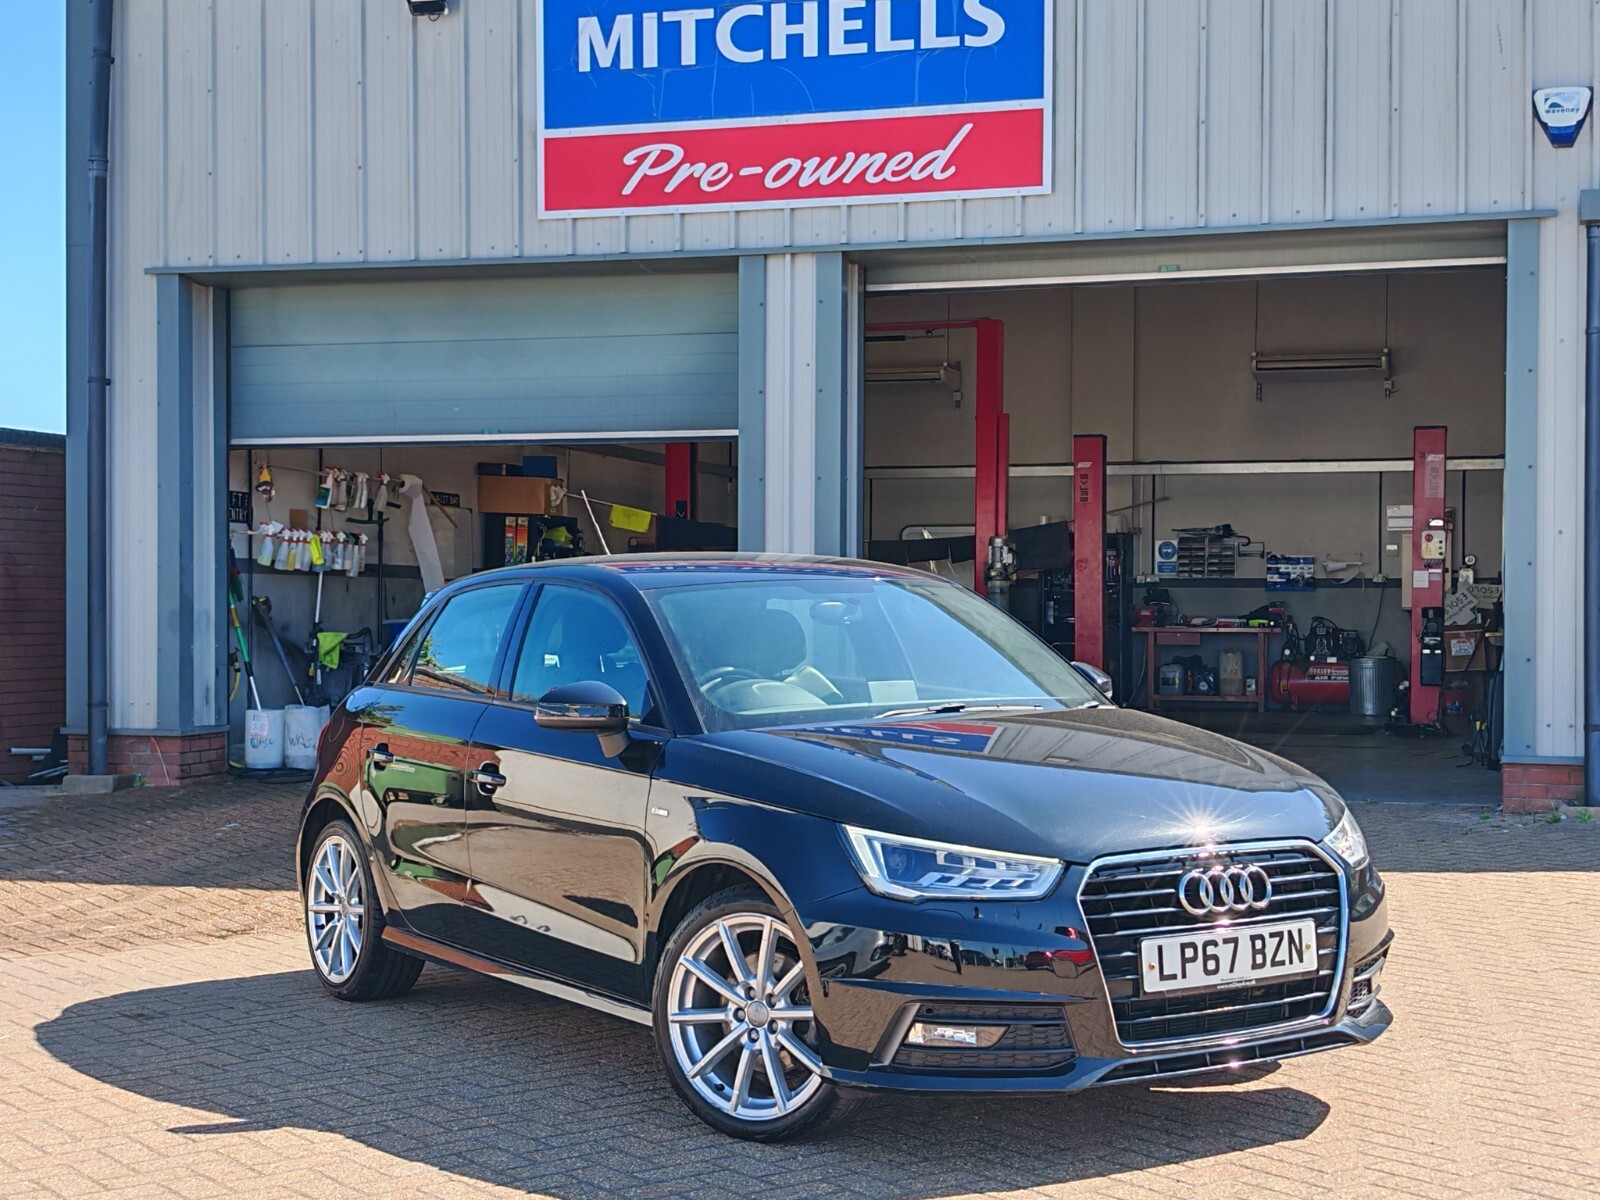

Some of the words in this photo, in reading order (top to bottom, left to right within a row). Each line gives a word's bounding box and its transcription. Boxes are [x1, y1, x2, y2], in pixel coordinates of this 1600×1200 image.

[577, 0, 1006, 73] MITCHELLS
[621, 123, 974, 196] Pre-owned
[1157, 936, 1239, 982] LP67
[1250, 928, 1304, 970] BZN
